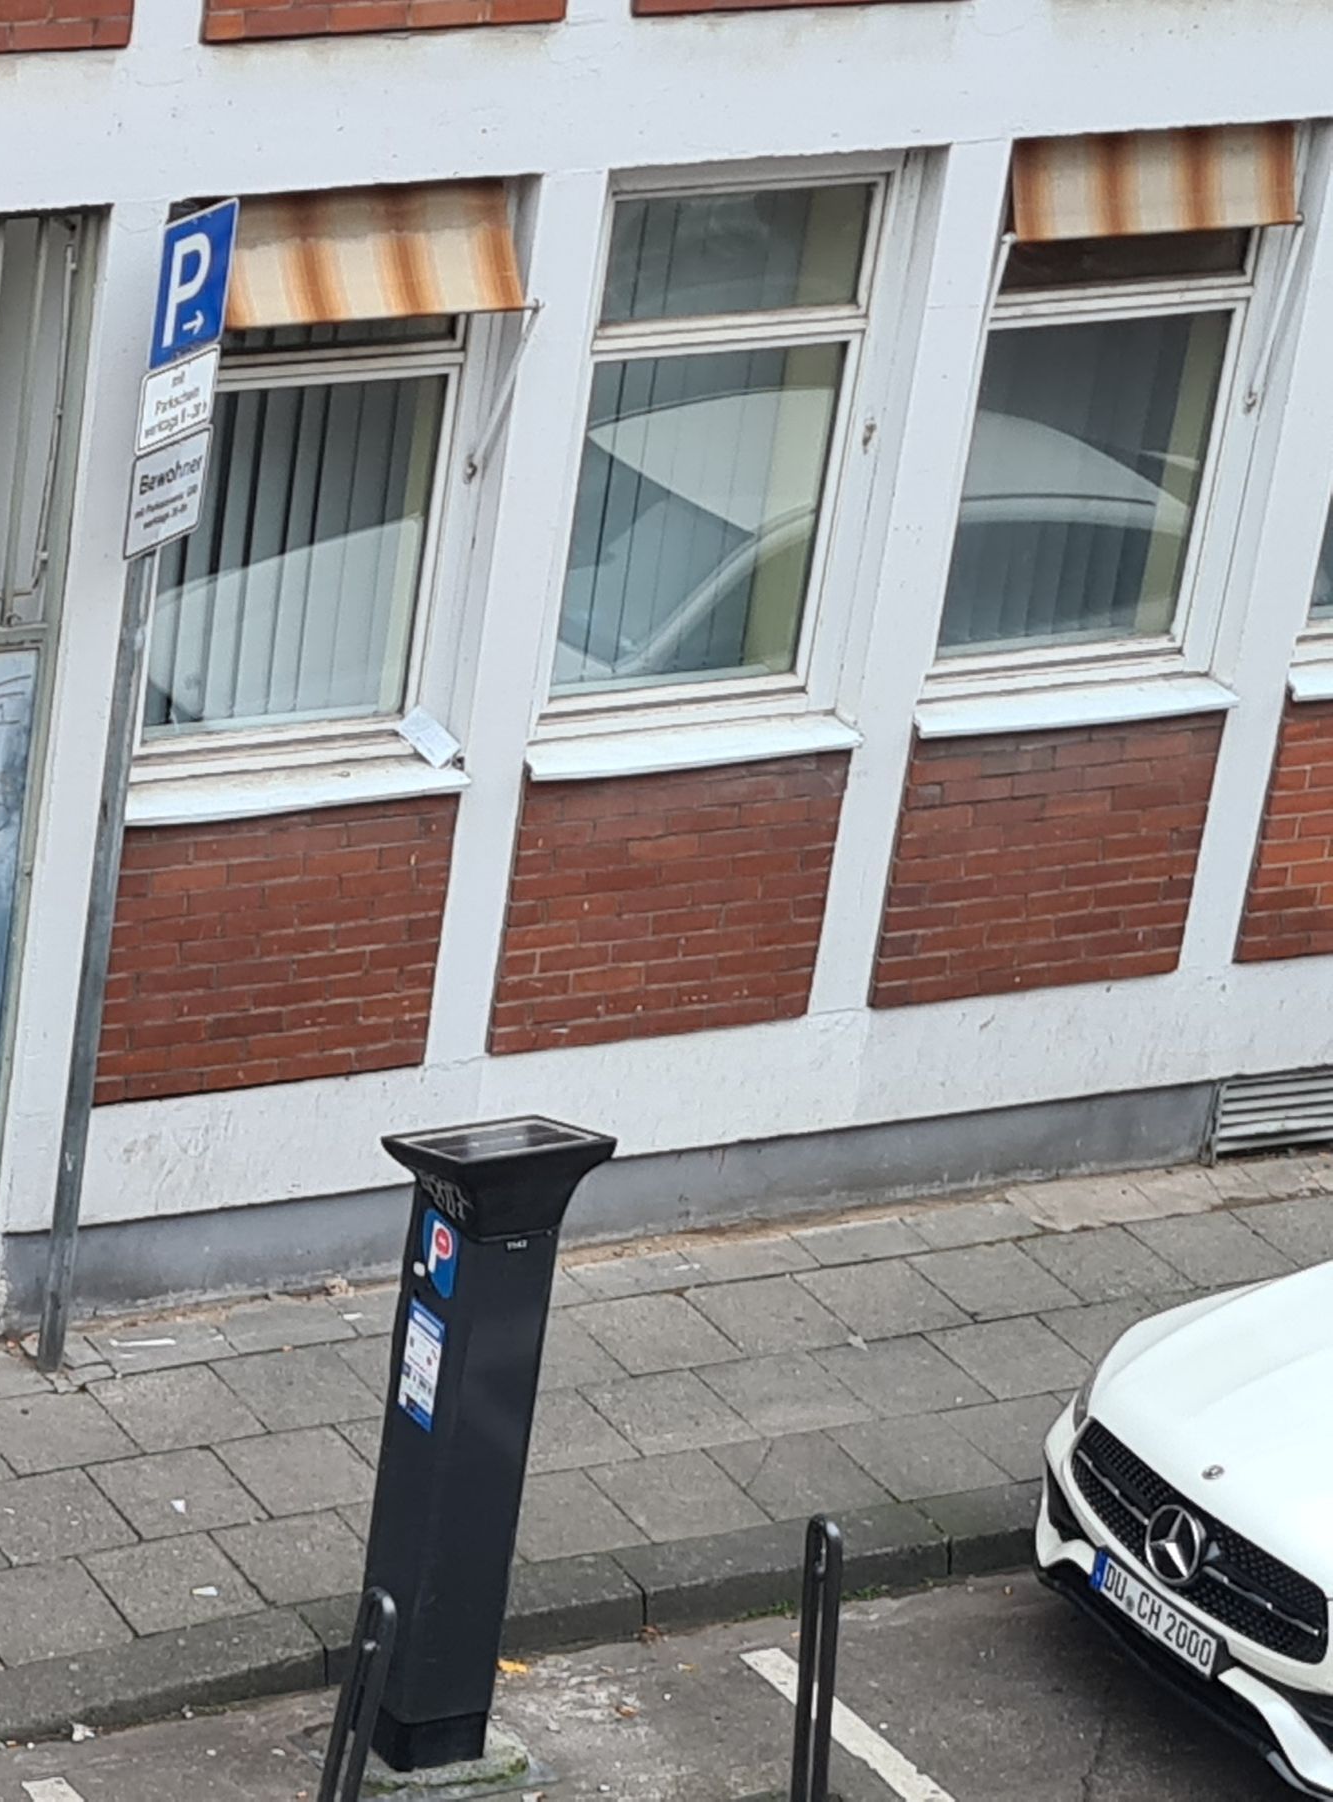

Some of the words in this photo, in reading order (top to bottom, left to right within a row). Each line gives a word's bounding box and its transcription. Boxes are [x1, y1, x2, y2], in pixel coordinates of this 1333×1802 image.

[161, 232, 211, 348] P
[138, 455, 203, 496] Bewohner
[1104, 1563, 1128, 1602] DU
[1137, 1591, 1162, 1630] CH
[1163, 1612, 1213, 1668] 2000
